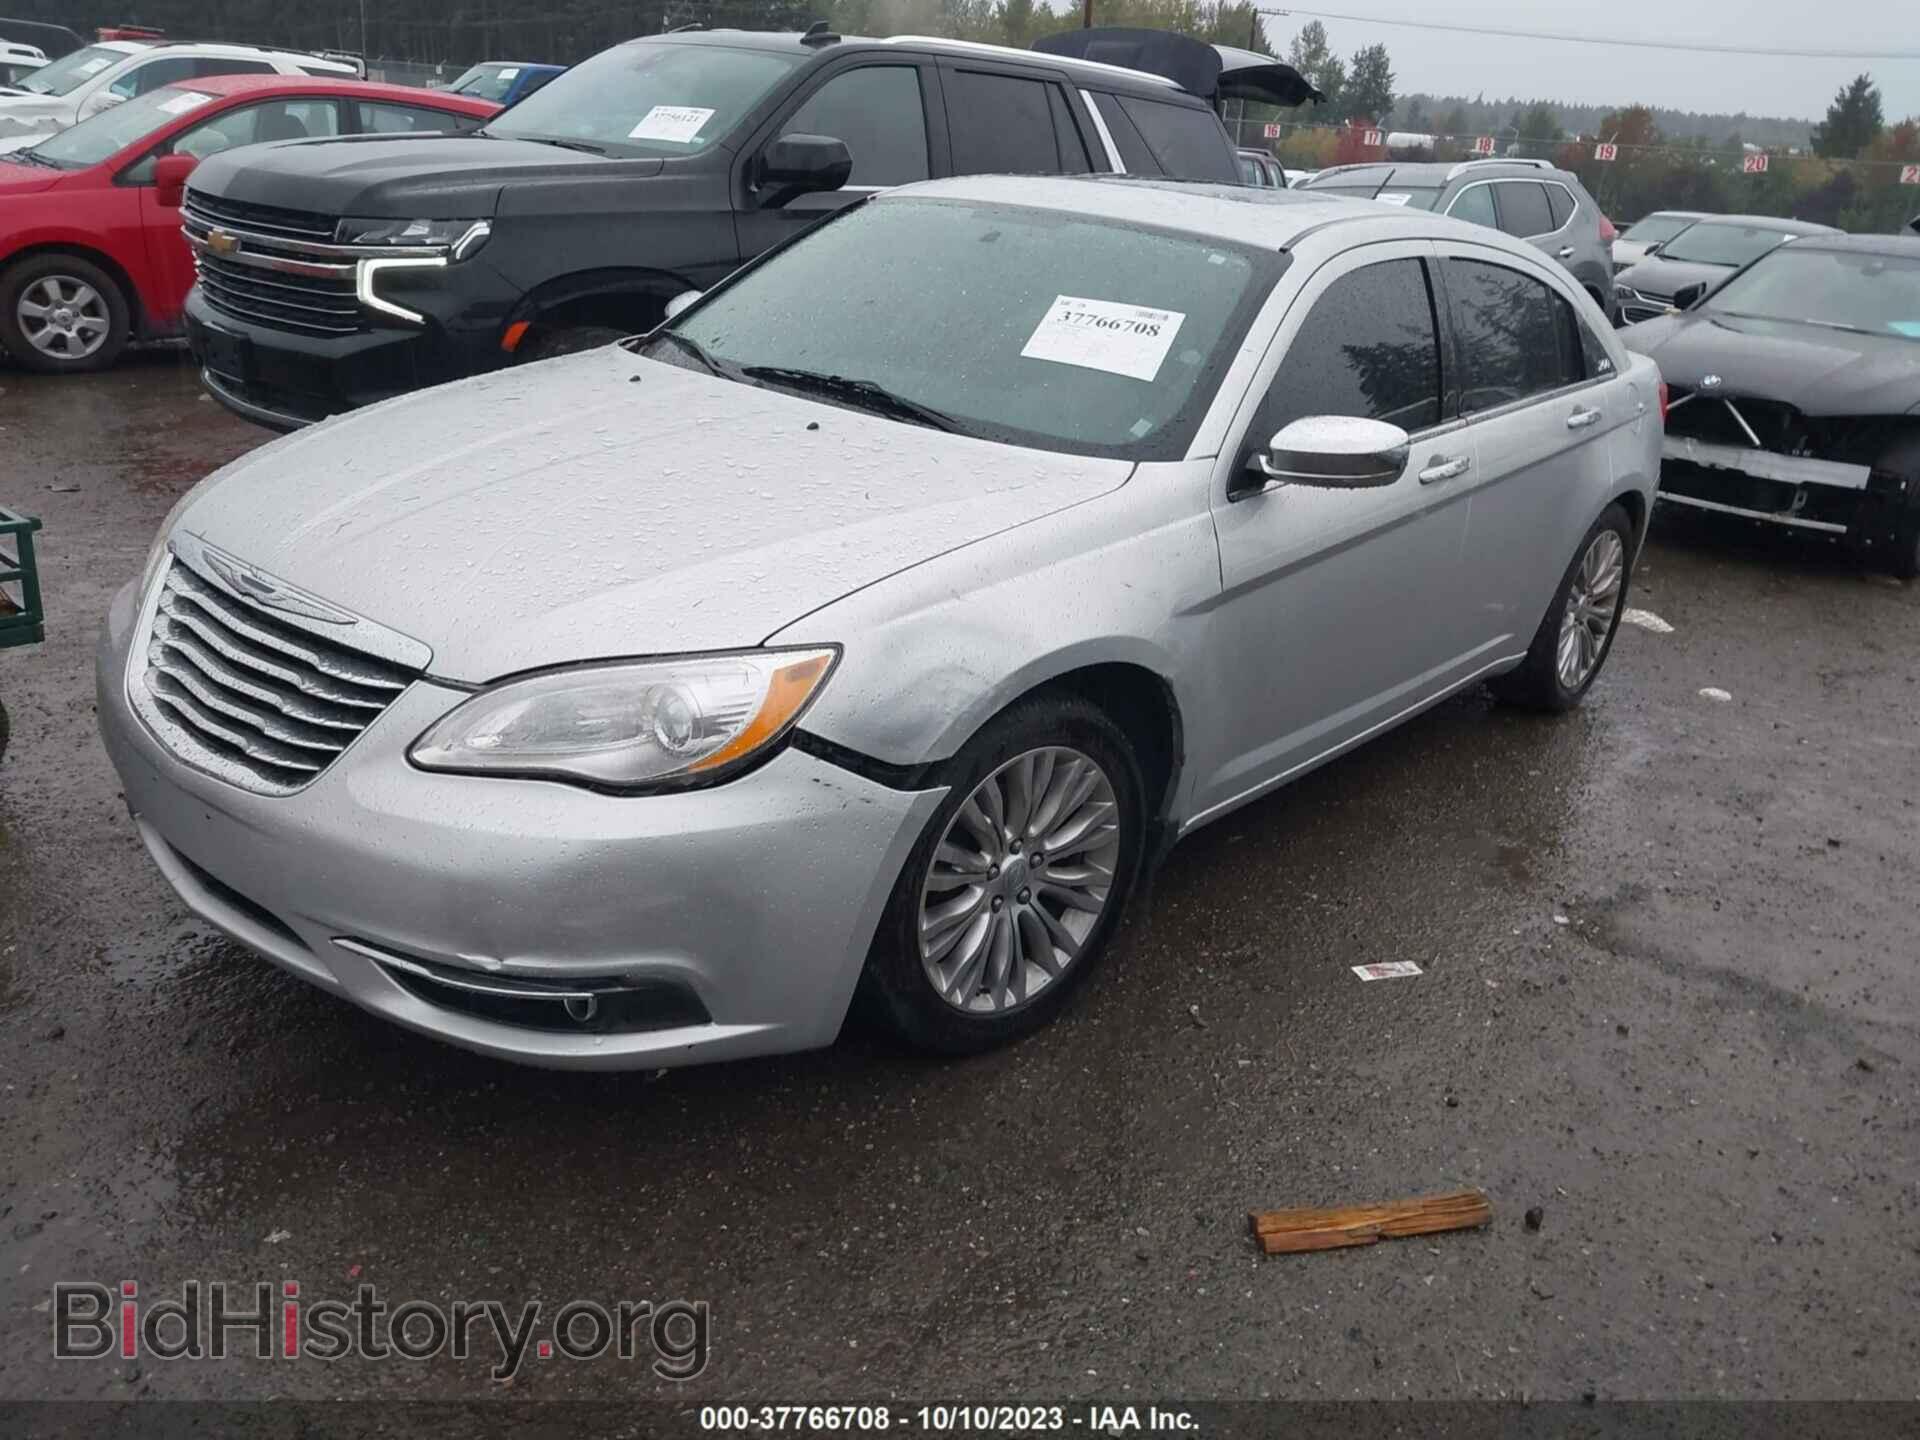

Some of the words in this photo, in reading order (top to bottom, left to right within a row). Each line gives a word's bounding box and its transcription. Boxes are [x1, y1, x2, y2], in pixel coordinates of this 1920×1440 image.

[1267, 124, 1278, 137] 16
[1479, 137, 1492, 152] 18
[1600, 145, 1614, 159] 19
[1746, 154, 1766, 172] 20
[1056, 310, 1161, 338] 37766708
